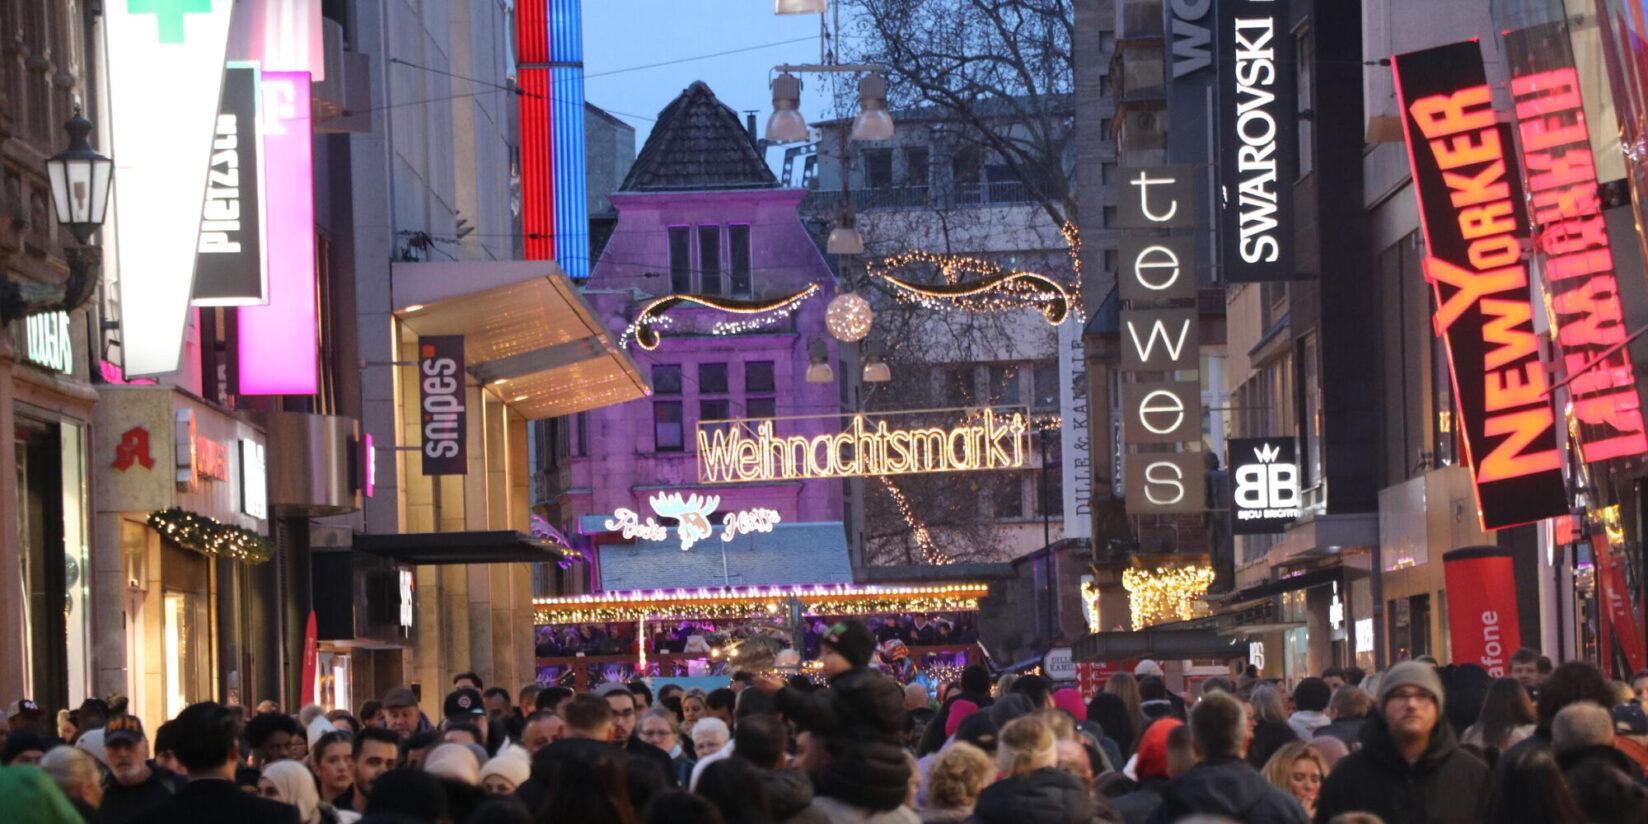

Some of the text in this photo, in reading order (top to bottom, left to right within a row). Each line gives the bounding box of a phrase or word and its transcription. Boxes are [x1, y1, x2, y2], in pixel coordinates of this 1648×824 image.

[1235, 16, 1279, 264] SWAROVSKI
[1127, 170, 1191, 506] tewes
[1410, 84, 1564, 485] NEW YORKER
[422, 357, 465, 460] snipes
[698, 408, 1026, 481] Weihnachtsmarkt
[1075, 457, 1092, 517] DILLE
